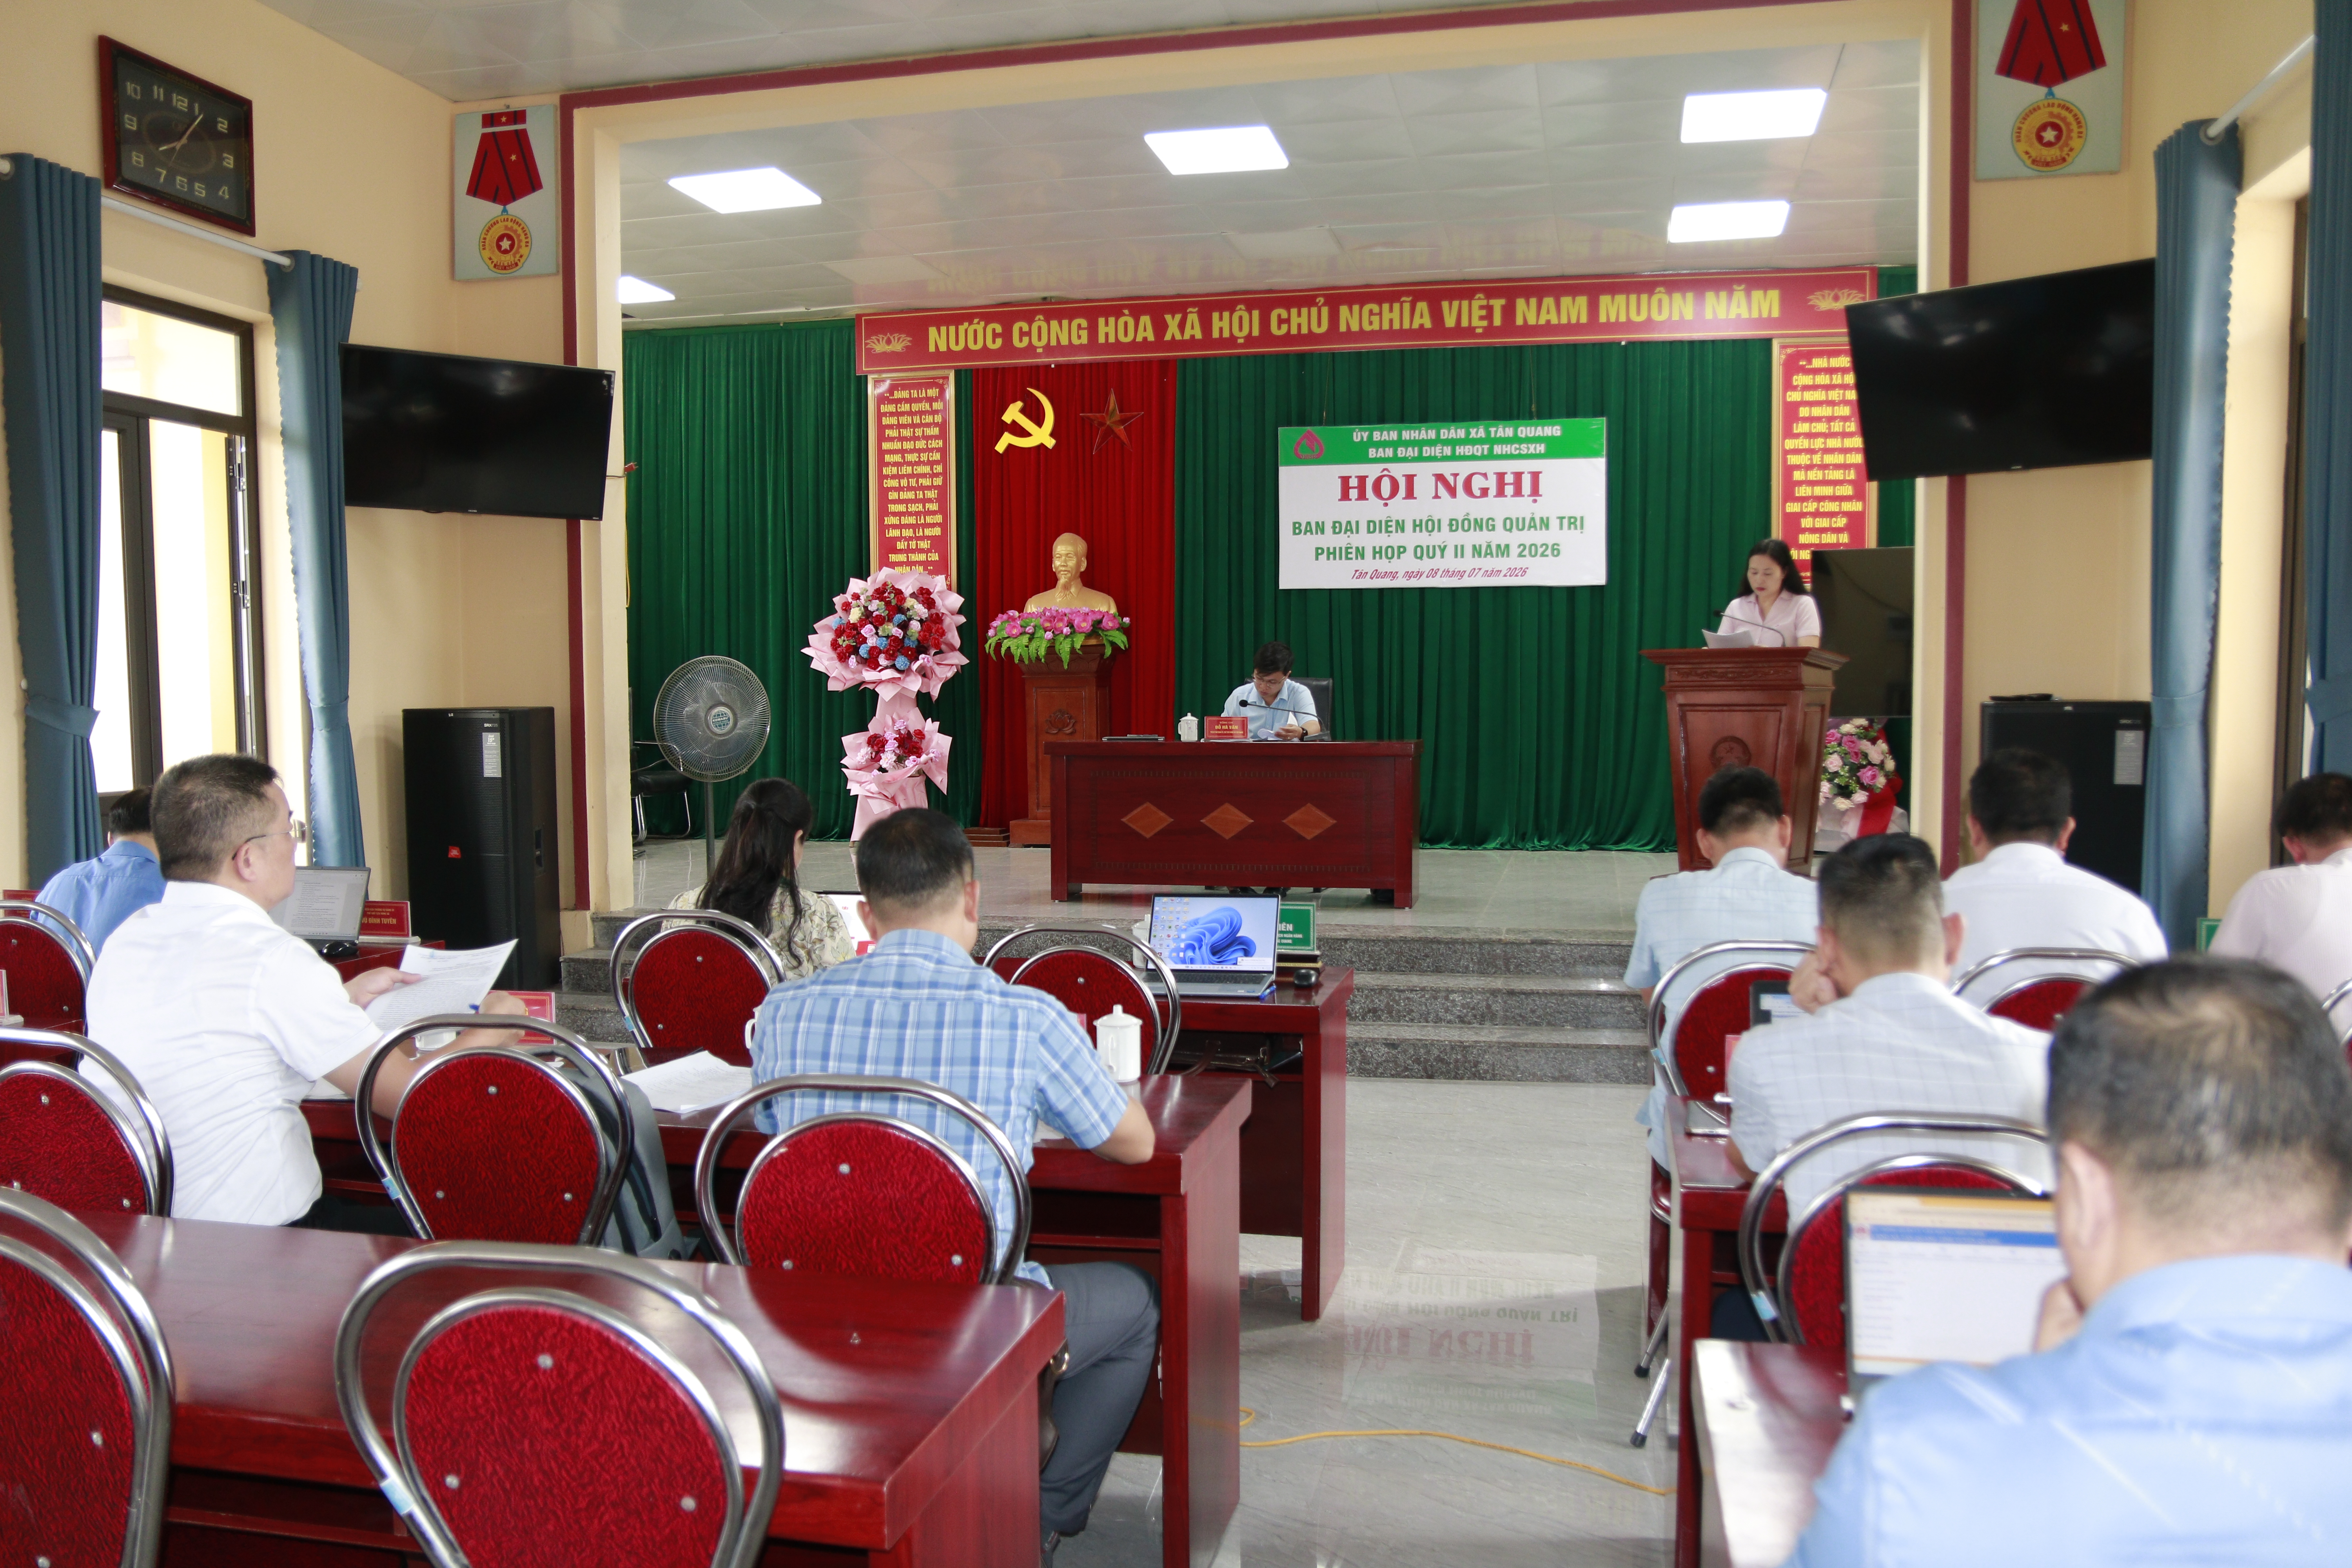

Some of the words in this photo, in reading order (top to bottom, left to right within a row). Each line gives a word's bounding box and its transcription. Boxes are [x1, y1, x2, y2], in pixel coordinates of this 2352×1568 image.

[125, 82, 141, 100] 10
[153, 85, 164, 102] 11
[172, 93, 188, 111] 12
[194, 103, 198, 115] 1
[124, 114, 137, 131] 9
[217, 118, 227, 133] 2
[132, 152, 143, 167] 8
[223, 153, 233, 168] 3
[156, 168, 167, 183] 7
[176, 176, 187, 191] 6
[194, 182, 205, 197] 5
[219, 186, 229, 200] 4
[928, 319, 1002, 352] NƯỚC
[1013, 315, 1088, 352] CỘNG
[1098, 310, 1154, 343] HÒA
[1163, 308, 1202, 341] XÃ
[1212, 305, 1259, 343] HỘI
[1270, 297, 1329, 335] CHỦ
[1339, 297, 1432, 332] NGHĨA
[1441, 294, 1505, 332] VIỆT
[1515, 296, 1588, 325] NAM
[1599, 287, 1694, 323] MUÔN
[1705, 285, 1780, 319] NĂM
[1829, 355, 1850, 367] NƯỚC
[911, 390, 917, 398] TA
[919, 388, 926, 397] LÀ
[927, 388, 939, 398] MỘT
[1799, 407, 1809, 417] DO
[1811, 405, 1832, 416] NHÂN
[1834, 404, 1849, 416] DÂN
[882, 414, 897, 425] ĐẢNG
[899, 415, 911, 424] VIÊN
[913, 415, 920, 423] VÀ
[922, 414, 933, 423] CÁN
[935, 413, 942, 424] BỘ
[886, 426, 898, 437] PHẢI
[900, 427, 913, 438] THẬT
[915, 427, 923, 437] SỰ
[924, 425, 939, 436] THẤM
[1353, 429, 1370, 442] ỦY
[1373, 431, 1397, 441] BAN
[1402, 427, 1435, 440] NHÂN
[1440, 427, 1465, 439] DÂN
[1469, 425, 1485, 438] XÃ
[1490, 426, 1513, 438] TÂN
[1517, 426, 1561, 438] QUANG
[1368, 447, 1393, 458] BAN
[1397, 446, 1418, 459] ĐẠI
[1422, 444, 1451, 459] DIỆN
[1456, 445, 1490, 457] HĐQT
[1494, 443, 1544, 455] NHCSXH
[1787, 453, 1810, 466] THUỘC
[1813, 451, 1821, 464] VỀ
[1824, 452, 1844, 464] NHÂN
[1846, 452, 1861, 463] DÂN
[883, 465, 897, 476] KIỆM
[899, 465, 912, 474] LIÊM
[914, 464, 931, 474] CHÍNH,
[933, 463, 942, 473] CHÍ
[1794, 468, 1805, 480] MÀ
[1807, 467, 1822, 480] NỀN
[1824, 466, 1844, 480] TẢNG
[1846, 468, 1855, 479] LÀ
[884, 478, 898, 487] CÔNG
[900, 477, 907, 486] VÔ
[909, 478, 917, 487] TƯ,
[919, 475, 931, 486] PHẢI
[933, 476, 943, 485] GIỮ
[1338, 468, 1417, 507] HỘI
[1432, 470, 1543, 503] NGHỊ
[889, 491, 898, 499] GÌN
[900, 488, 915, 499] ĐẢNG
[925, 489, 938, 500] THẬT
[1795, 485, 1811, 496] LIÊN
[1814, 486, 1833, 495] MINH
[1835, 484, 1853, 495] GIỮA
[908, 504, 924, 513] SẠCH,
[926, 499, 938, 511] PHẢI
[1786, 503, 1800, 512] GIAI
[1803, 499, 1817, 512] CẤP
[1819, 500, 1839, 512] CÔNG
[1841, 499, 1862, 511] NHÂN
[884, 515, 899, 524] XỨNG
[901, 515, 916, 524] ĐÁNG
[918, 514, 924, 523] LÀ
[926, 514, 942, 523] NGƯỜI
[1292, 521, 1325, 536] BAN
[1331, 520, 1359, 538] ĐẠI
[1366, 515, 1405, 538] DIỆN
[1412, 514, 1441, 537] HỘI
[1447, 513, 1496, 533] ĐỒNG
[1502, 512, 1549, 534] QUẢN
[1556, 515, 1584, 535] TRỊ
[1801, 515, 1813, 528] VỚI
[1815, 518, 1829, 527] GIAI
[1832, 514, 1846, 527] CẤP
[886, 528, 900, 537] LÃNH
[902, 529, 915, 538] ĐẠO,
[916, 527, 923, 536] LÀ
[924, 526, 941, 536] NGƯỜI
[1799, 532, 1819, 544] NÔNG
[1822, 532, 1837, 543] DÂN
[1838, 532, 1848, 543] VÀ
[908, 552, 926, 561] THÀNH
[928, 550, 939, 561] CỦA
[1314, 542, 1365, 561] PHIÊN
[1372, 546, 1406, 564] HỌP
[1413, 541, 1447, 560] QUÝ
[1454, 545, 1463, 559] II
[1471, 541, 1509, 559] NĂM
[1517, 542, 1561, 559] 2026
[1351, 569, 1368, 580] Tân
[1369, 568, 1399, 582] Quang,
[1401, 568, 1424, 581] ngày
[1426, 568, 1439, 579] 08
[1440, 568, 1466, 580] tháng
[1468, 568, 1480, 578] 07
[1482, 568, 1501, 578] năm
[1503, 567, 1529, 577] 2026
[1279, 922, 1292, 931] IÊN
